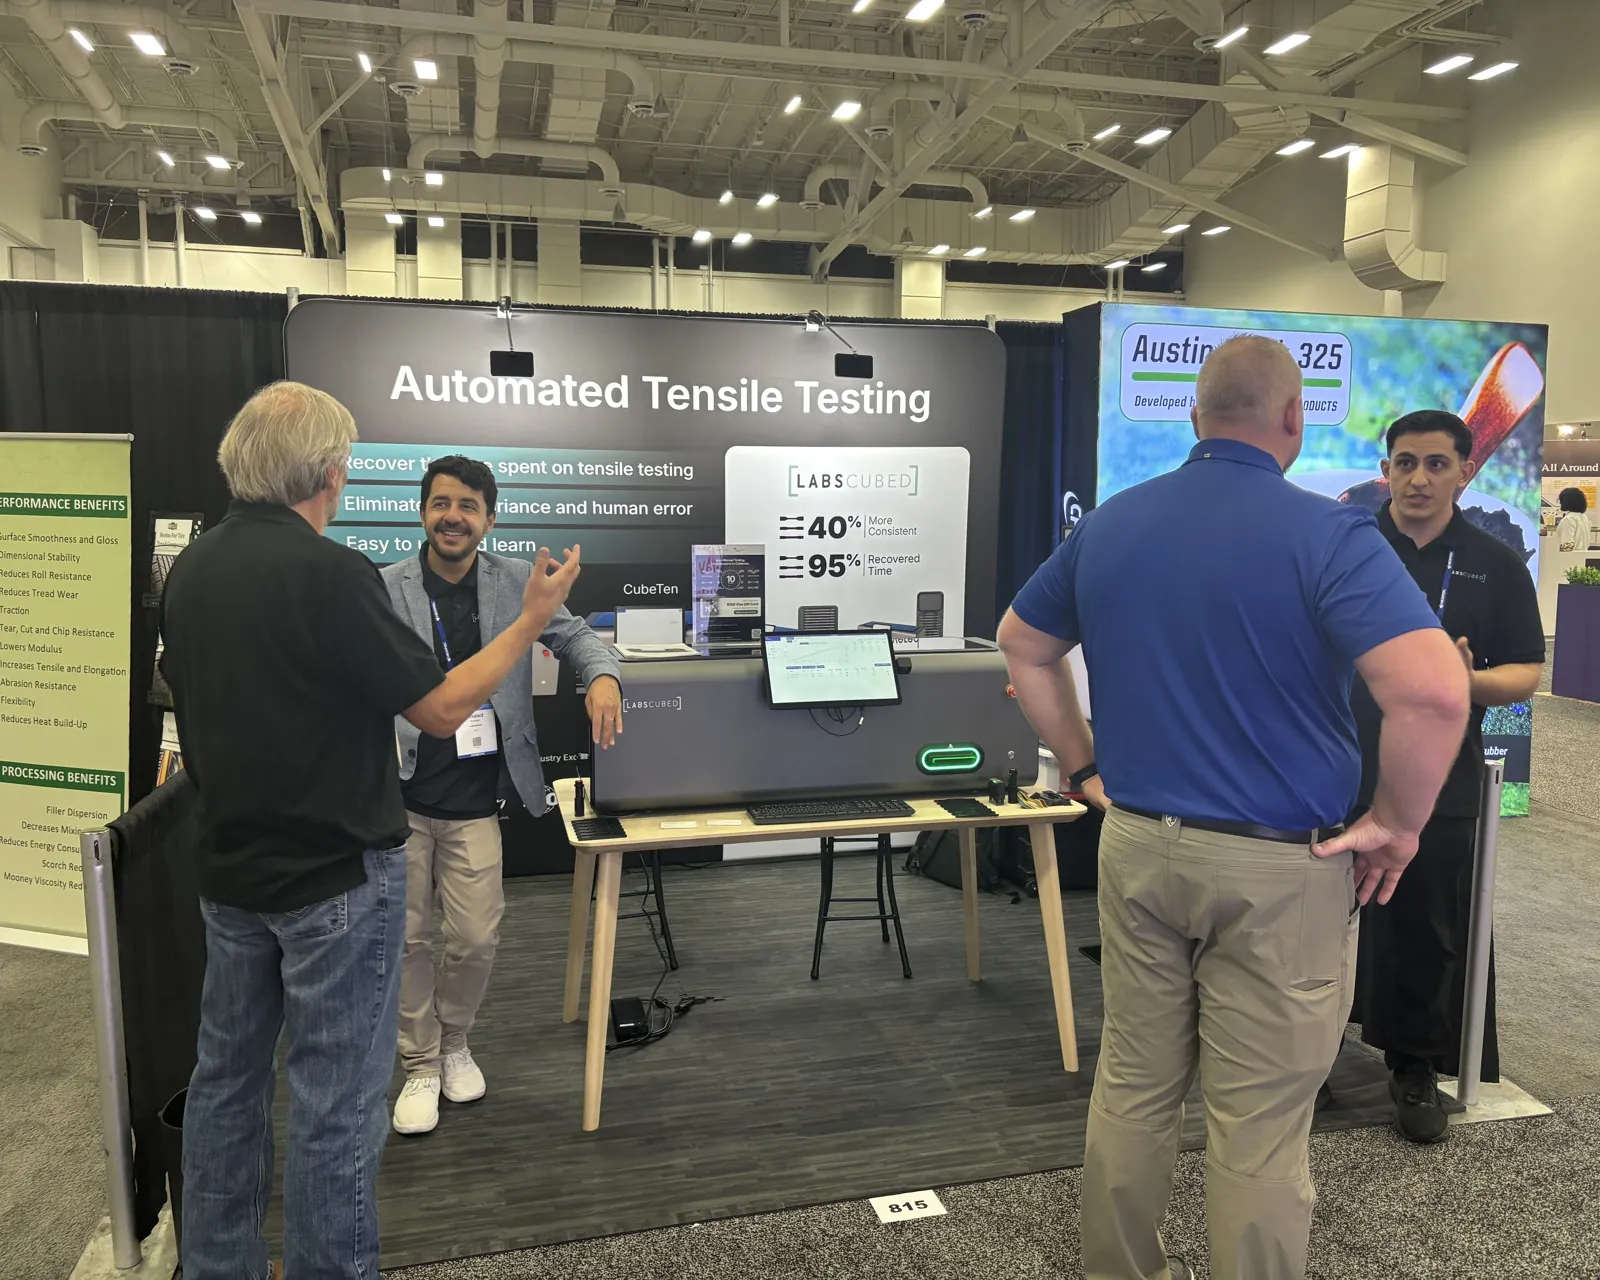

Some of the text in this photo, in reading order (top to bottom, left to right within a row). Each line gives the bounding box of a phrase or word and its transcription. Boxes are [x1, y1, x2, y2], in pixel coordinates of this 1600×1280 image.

[1132, 335, 1213, 364] Austin
[1298, 343, 1343, 369] 325
[390, 365, 931, 423] Automated Tensile Testing
[1135, 395, 1187, 410] Developed
[1304, 400, 1338, 411] ODUCTS
[498, 461, 547, 476] spent
[552, 462, 573, 475] on
[577, 462, 633, 476] tensile
[638, 462, 694, 480] testing
[1542, 463, 1599, 472] All Around
[73, 499, 126, 511] BENEFITS
[495, 498, 550, 514] riance
[556, 501, 587, 515] and
[592, 501, 648, 515] human
[653, 504, 693, 516] error
[807, 515, 862, 539] 40%
[868, 516, 893, 525] More
[868, 527, 917, 536] Consistent
[28, 534, 77, 544] Smoothness
[79, 536, 94, 544] and
[96, 536, 119, 545] Gloss
[346, 536, 389, 553] Easy
[395, 537, 412, 551] to
[492, 537, 536, 552] learn
[0, 551, 81, 563] Dimensional Stability
[868, 554, 920, 564] Recovered
[808, 553, 861, 578] 95%
[868, 566, 893, 576] Time
[0, 569, 92, 581] Reduces Roll Resistance
[726, 575, 736, 583] 10
[0, 587, 79, 599] Reduces Tread Wear
[623, 583, 679, 595] CubeTen
[0, 605, 30, 615] Traction
[0, 624, 115, 638] Tear, Cut and Chip Resistance
[0, 642, 63, 654] Lowers Modulus
[0, 661, 127, 676] Increases Tensile and Elongation
[0, 678, 77, 691] Abrasion Resistance
[0, 695, 36, 708] Flexibility
[1, 714, 88, 730] Reduces Heat Build-Up
[1484, 746, 1508, 756] ubber
[540, 755, 561, 763] ustry
[1, 766, 117, 786] PROCESSING BENEFITS
[46, 805, 108, 820] Filler Dispersion
[21, 821, 81, 835] Decreases Mixin
[0, 836, 80, 853] Reduces Energy Consu
[42, 860, 67, 870] Scorch
[4, 872, 83, 890] Mooney Viscosity Red
[888, 1200, 928, 1213] 815
